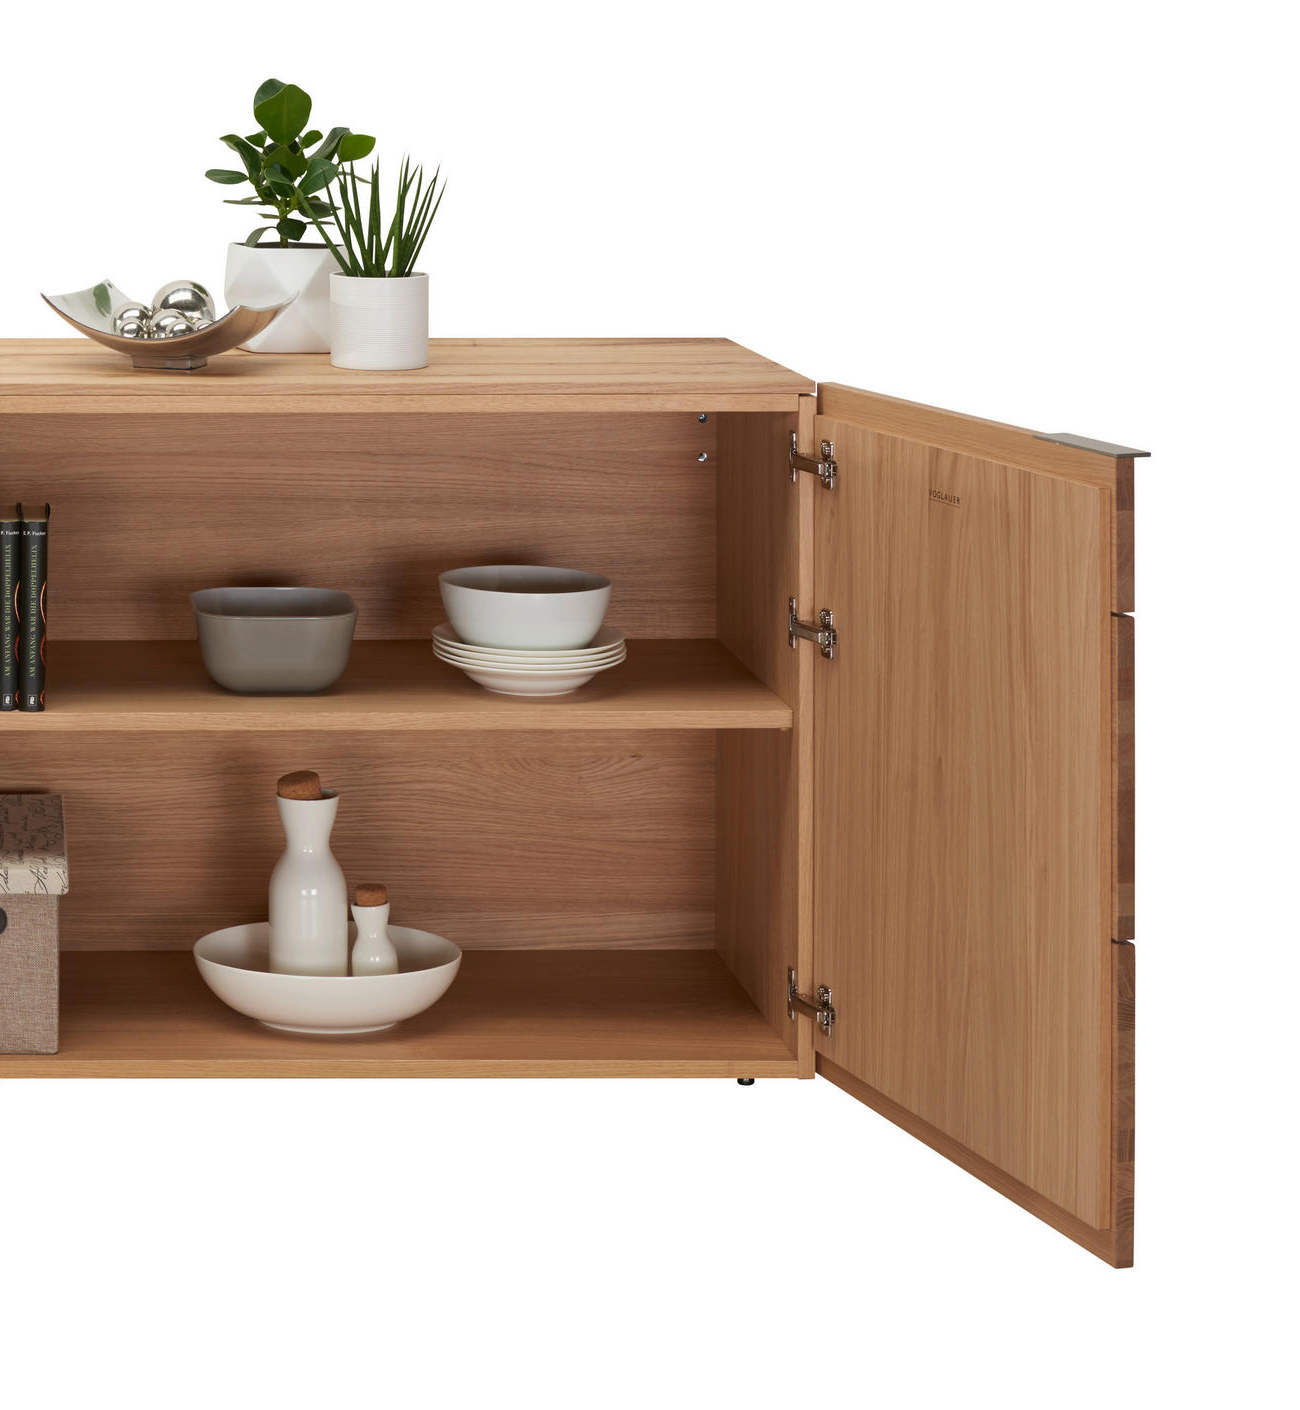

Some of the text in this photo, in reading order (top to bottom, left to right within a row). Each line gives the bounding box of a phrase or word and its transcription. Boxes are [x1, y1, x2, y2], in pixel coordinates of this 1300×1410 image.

[929, 488, 961, 504] VOGLAUER
[30, 544, 38, 598] DOPPELHELIX
[4, 666, 11, 677] AM
[29, 666, 36, 678] AM
